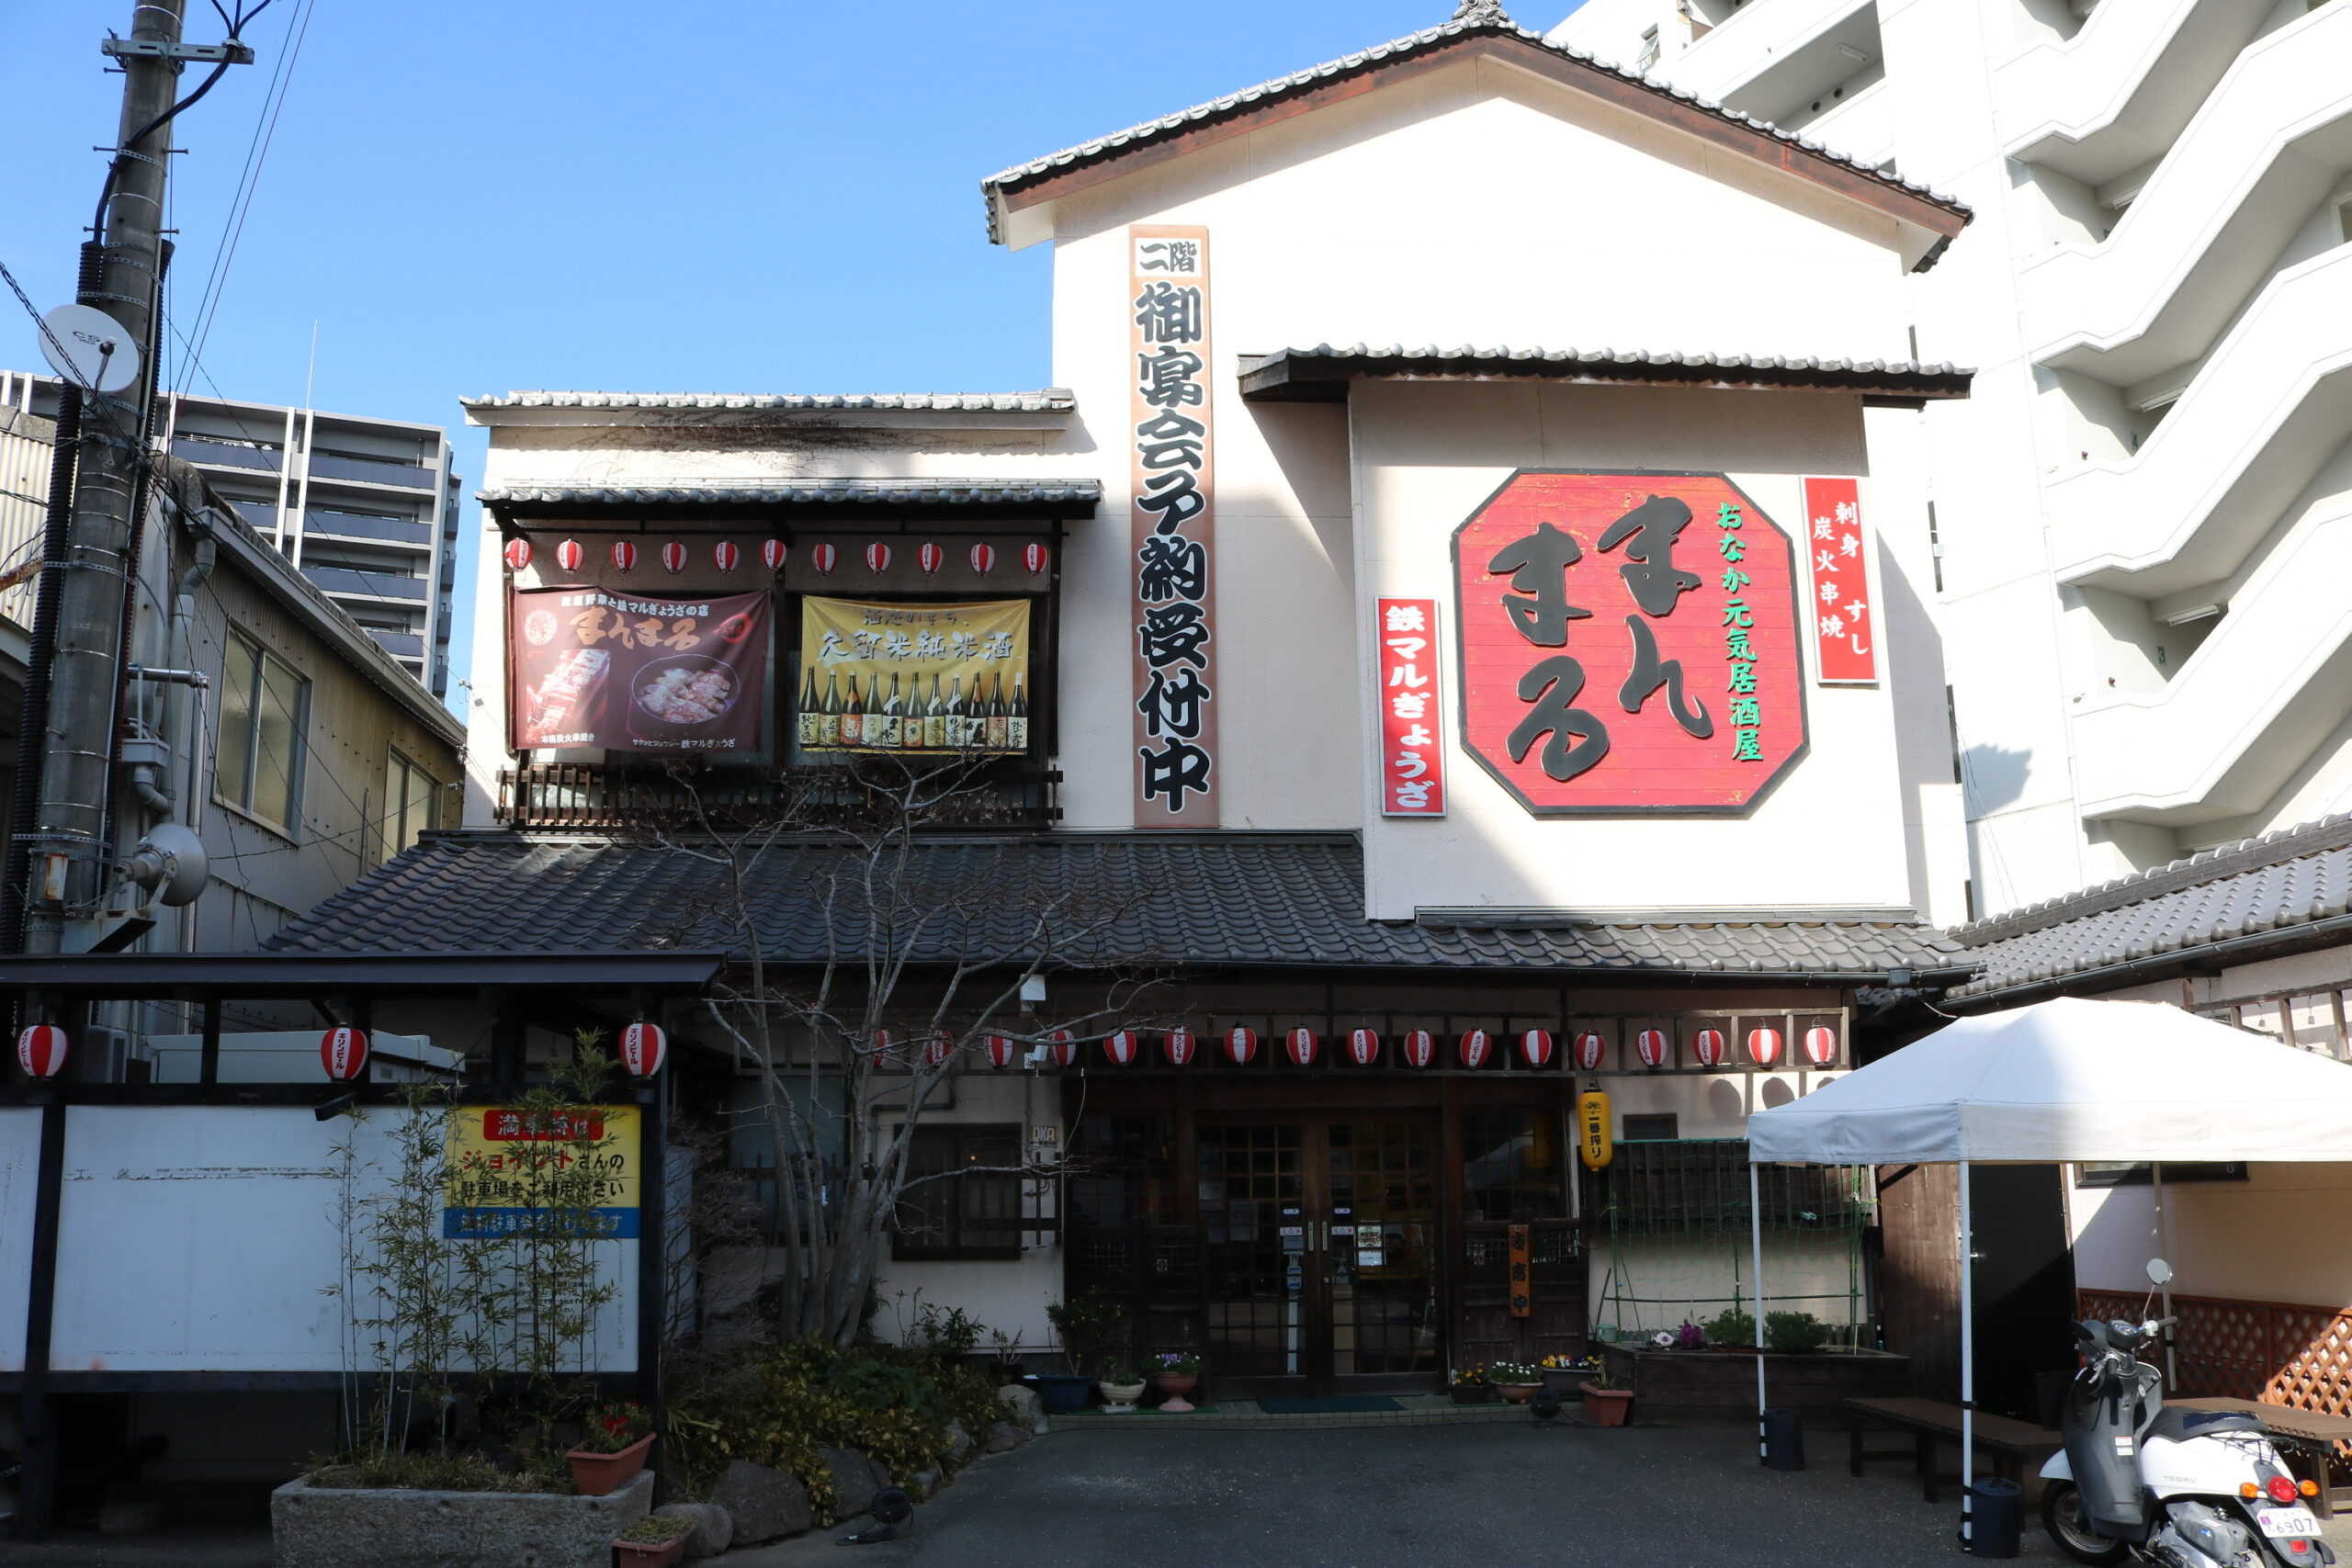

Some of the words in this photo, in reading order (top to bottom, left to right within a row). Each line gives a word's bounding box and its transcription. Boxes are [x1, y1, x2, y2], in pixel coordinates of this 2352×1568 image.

[1139, 241, 1197, 274] 二階
[1135, 282, 1210, 813] 御宴会予約受付中
[1835, 502, 1860, 558] 刺身
[1813, 516, 1846, 640] 炭火串焼
[569, 606, 700, 651] まんまる
[1595, 494, 1713, 739] まん
[1715, 502, 1763, 762] おなか元気居酒屋
[1843, 599, 1869, 656] すし
[820, 628, 1013, 662] 久留米純米酒
[1487, 523, 1610, 782] まる
[1385, 605, 1436, 809] 鉄マルぎょうざ
[21, 1031, 30, 1068] キリンビール
[336, 1033, 346, 1069] キリンビール
[629, 1028, 639, 1066] キリンビール
[1589, 1117, 1601, 1158] 一番搾り
[2276, 1517, 2313, 1534] 6907
